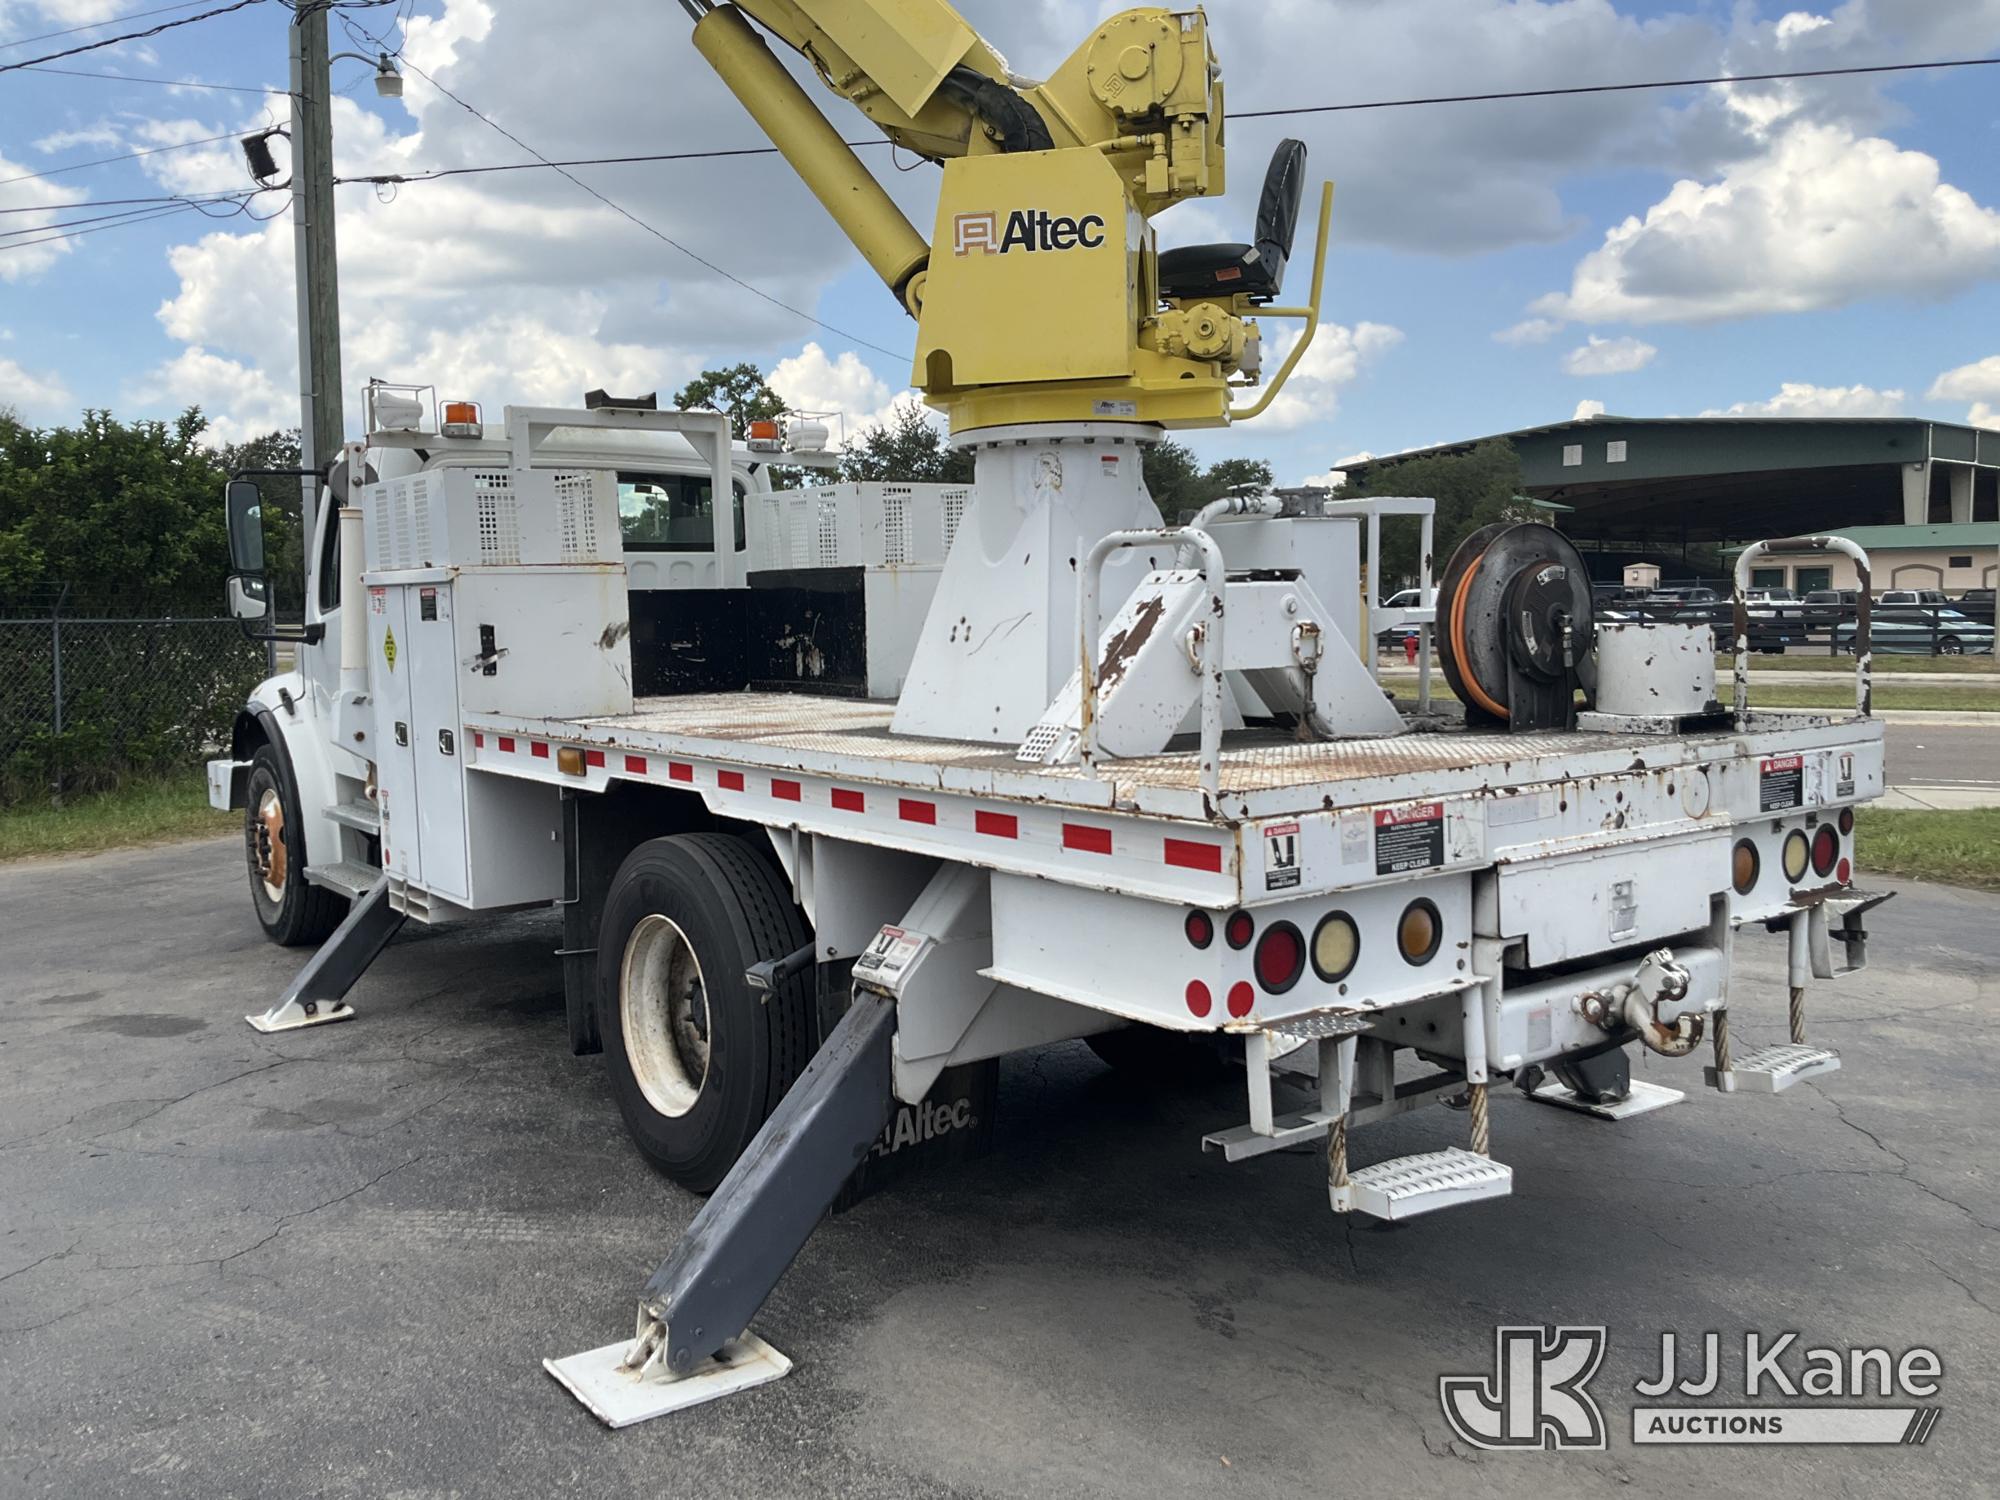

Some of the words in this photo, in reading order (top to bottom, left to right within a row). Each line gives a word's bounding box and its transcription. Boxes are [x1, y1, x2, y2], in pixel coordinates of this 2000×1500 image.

[999, 209, 1105, 254] Altec
[1773, 758, 1798, 769] DANGER
[1392, 861, 1408, 871] KEEP
[1408, 858, 1431, 868] CLEAR
